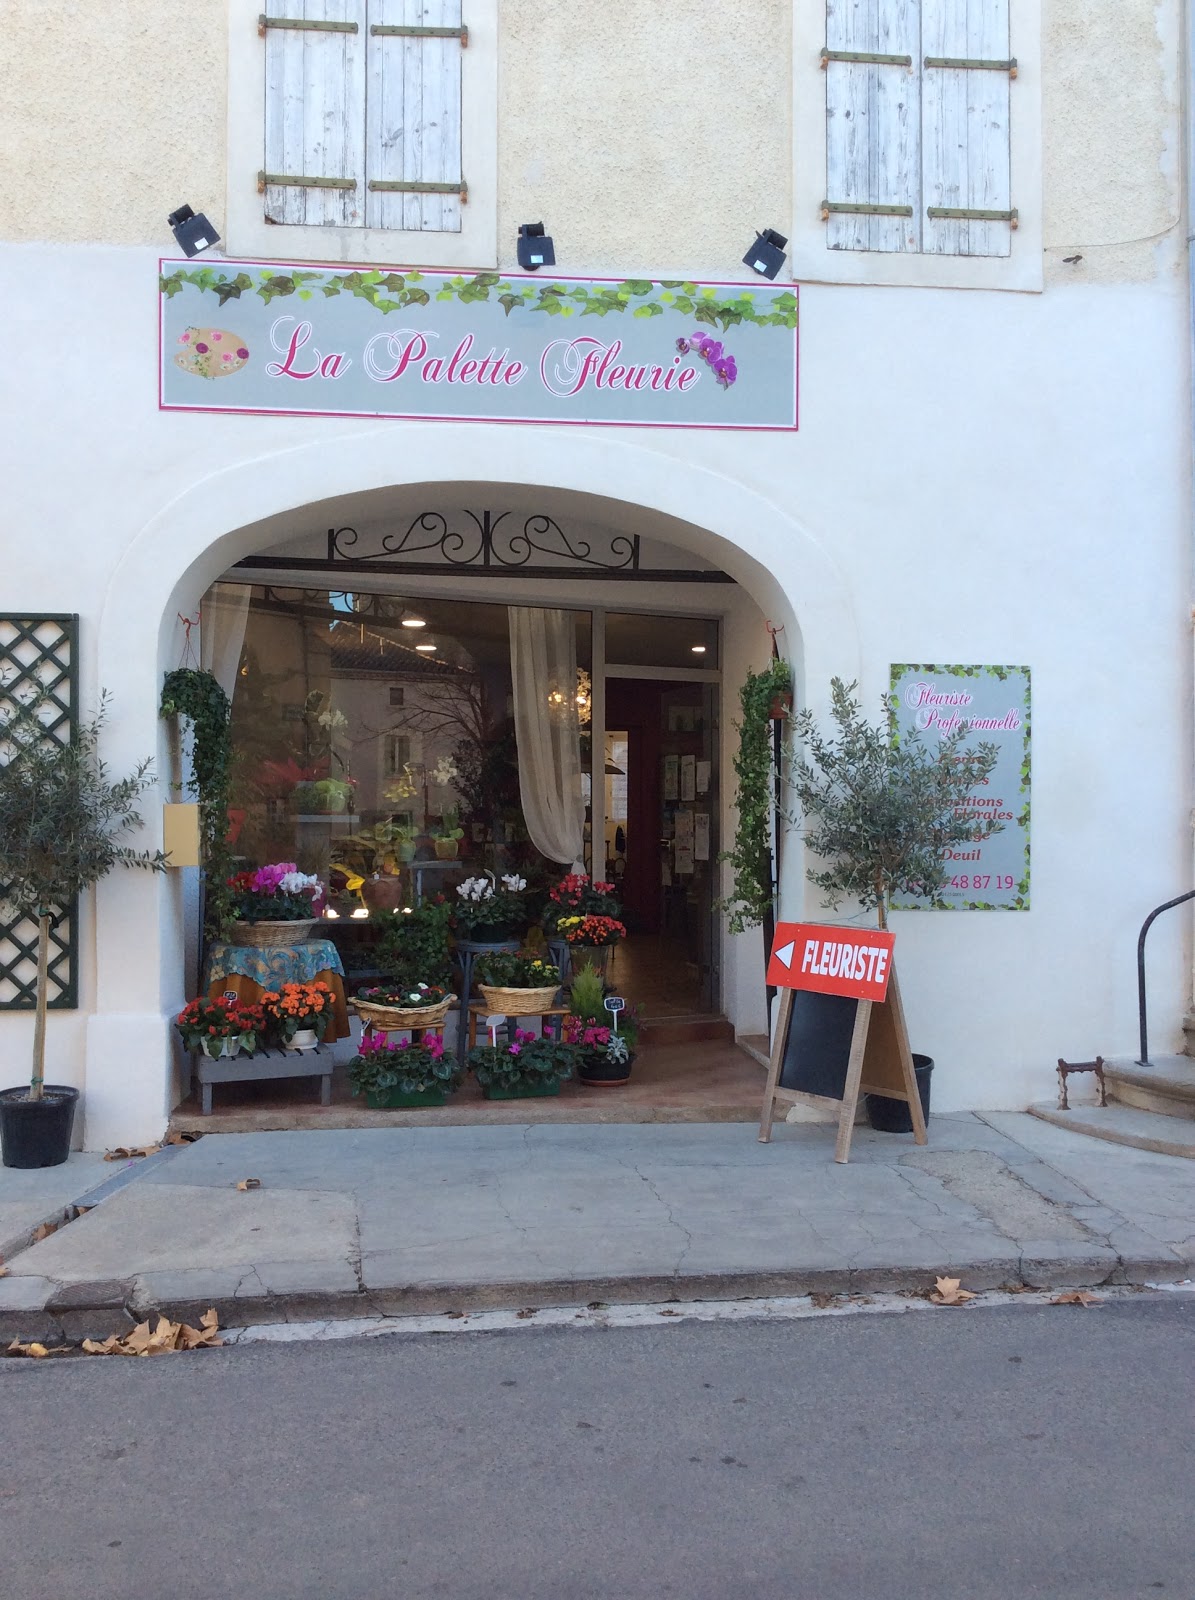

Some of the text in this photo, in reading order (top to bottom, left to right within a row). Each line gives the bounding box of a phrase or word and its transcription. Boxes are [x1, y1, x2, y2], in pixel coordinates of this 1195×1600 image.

[265, 315, 701, 397] La Palette Fleurie
[905, 681, 972, 709] Fleuriste
[954, 807, 1014, 820] Florales
[942, 848, 981, 861] Deuil
[950, 875, 969, 889] 48
[973, 875, 991, 889] 87
[996, 875, 1014, 889] 19
[801, 939, 889, 983] FLEURISTE
